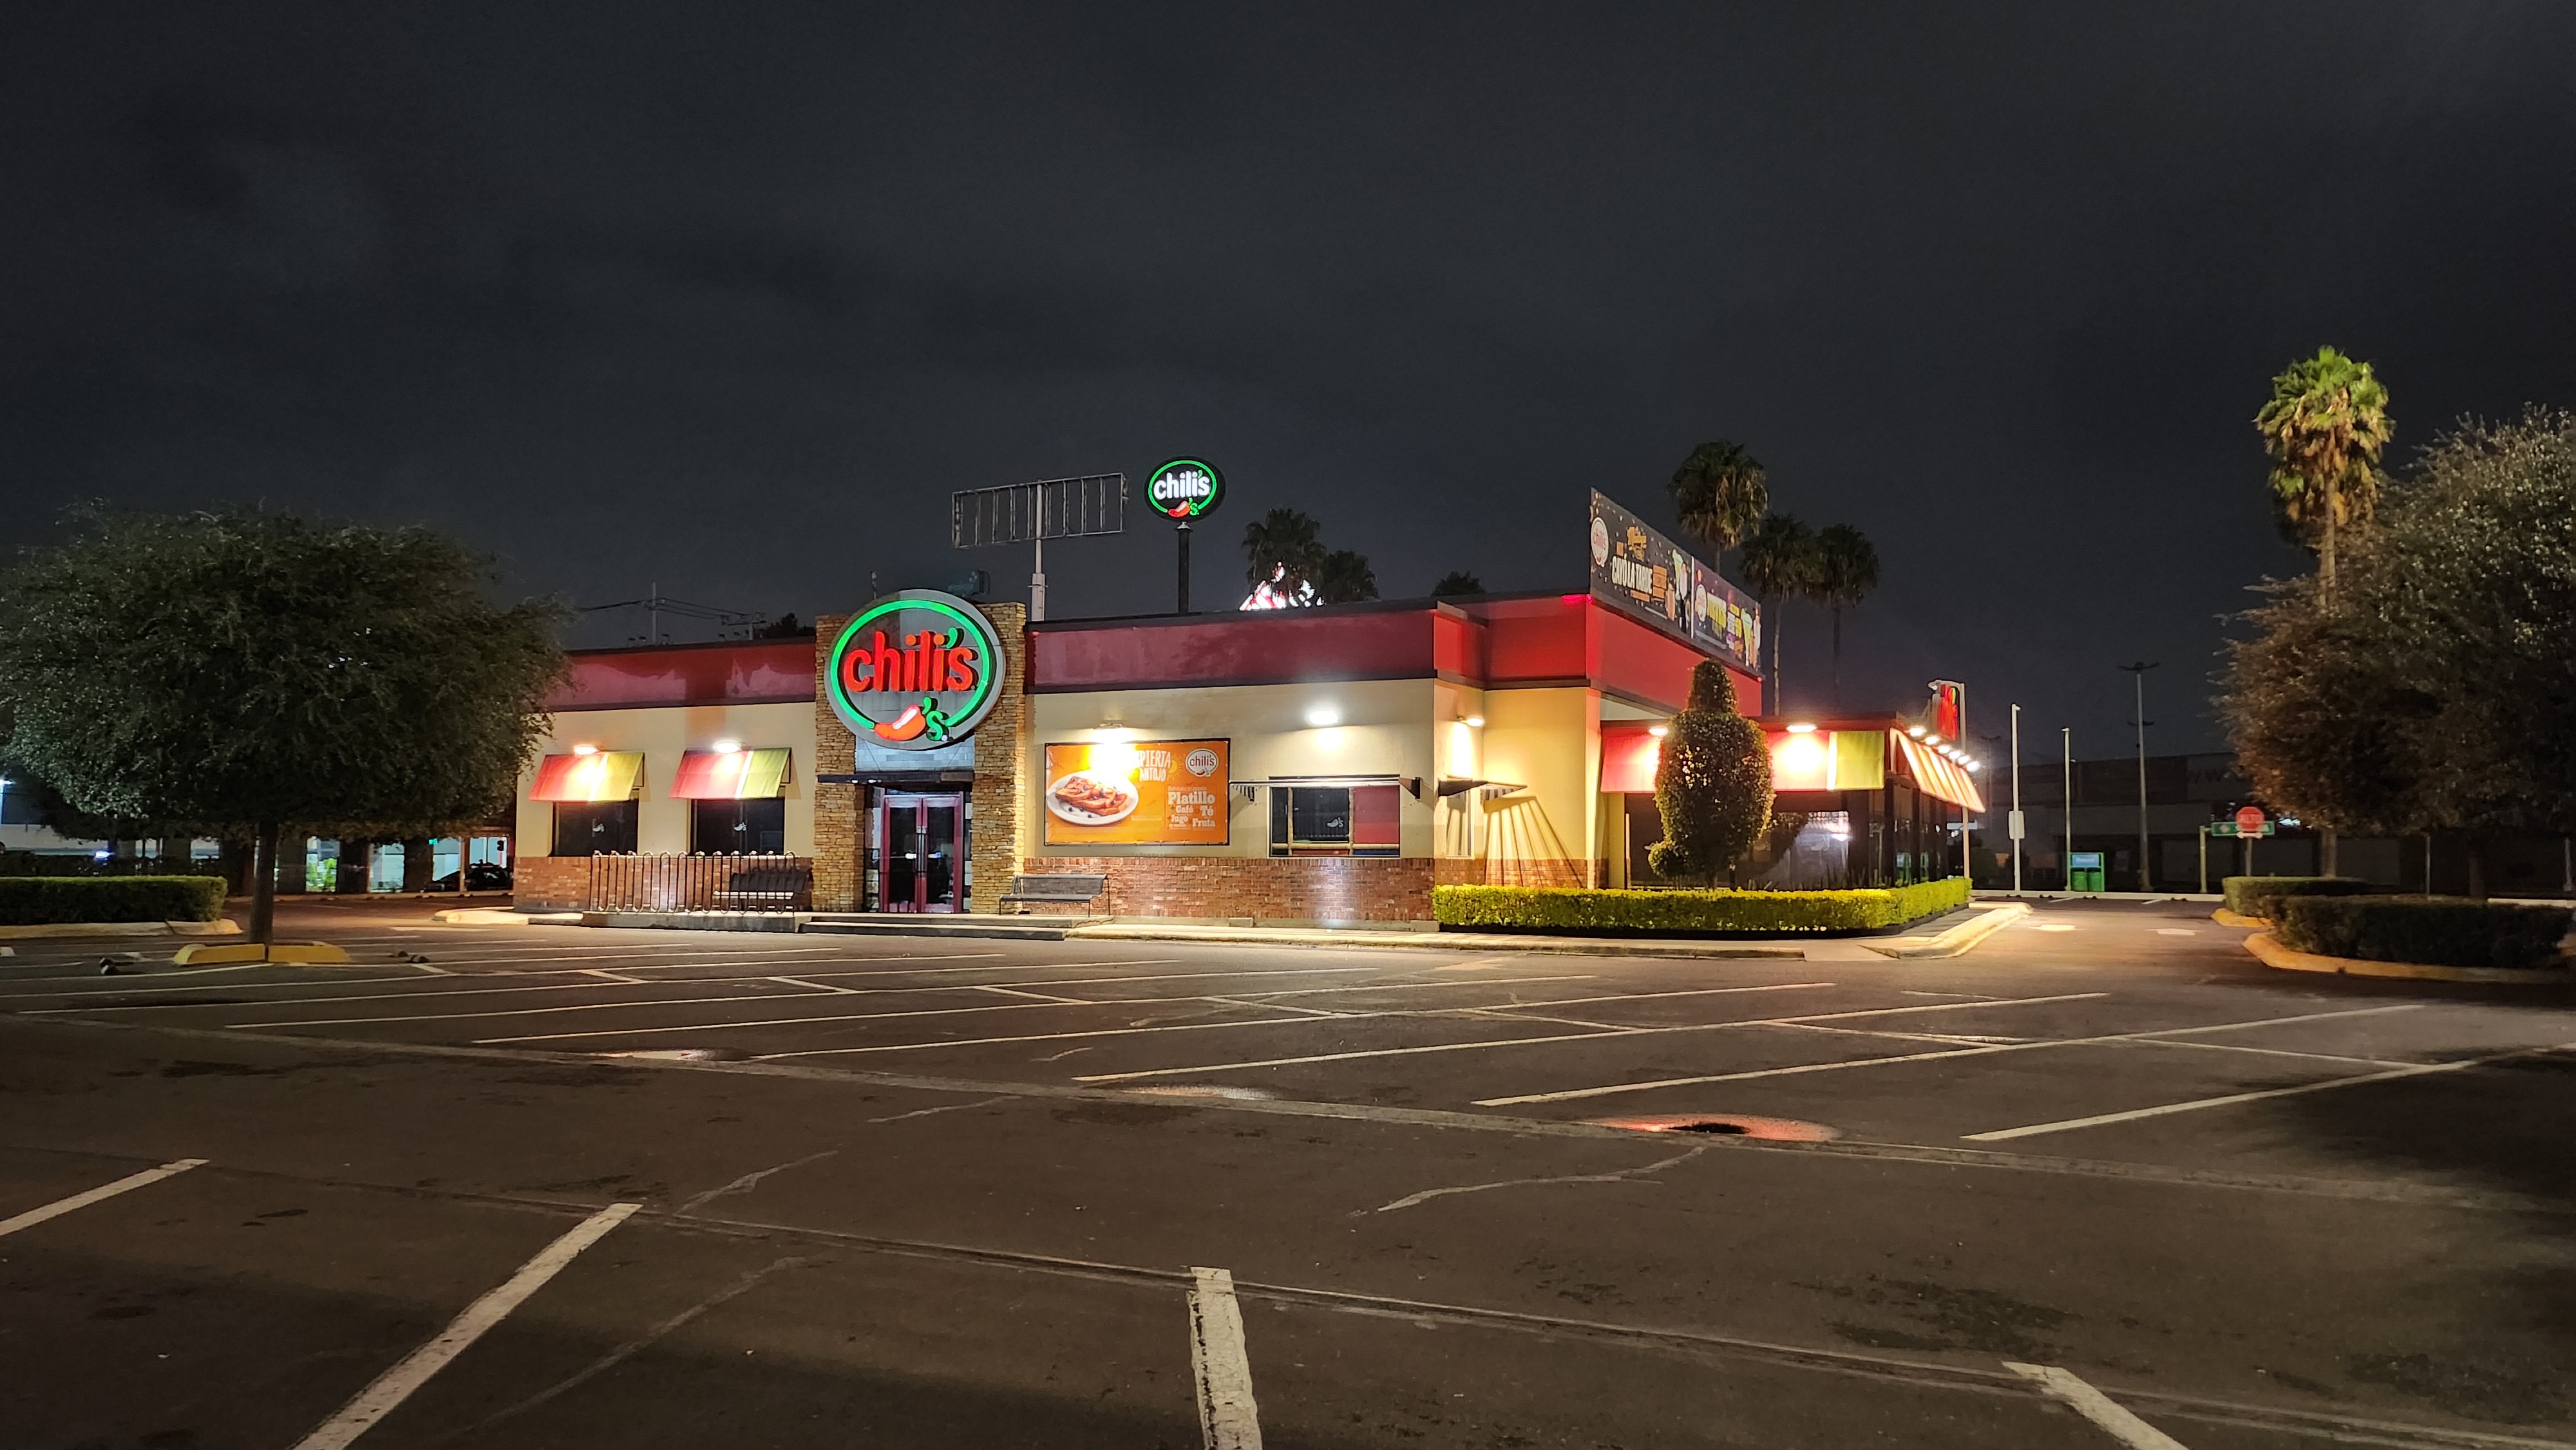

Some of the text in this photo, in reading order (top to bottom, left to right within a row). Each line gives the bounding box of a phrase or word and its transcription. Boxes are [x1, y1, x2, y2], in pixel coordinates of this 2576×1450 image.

[1153, 469, 1211, 500] chili's
[843, 626, 975, 693] chili's
[1189, 754, 1215, 767] chili's
[1168, 791, 1216, 805] Platillo
[1175, 804, 1194, 813] Café
[1200, 805, 1214, 816] Té
[1192, 818, 1216, 827] Fruta
